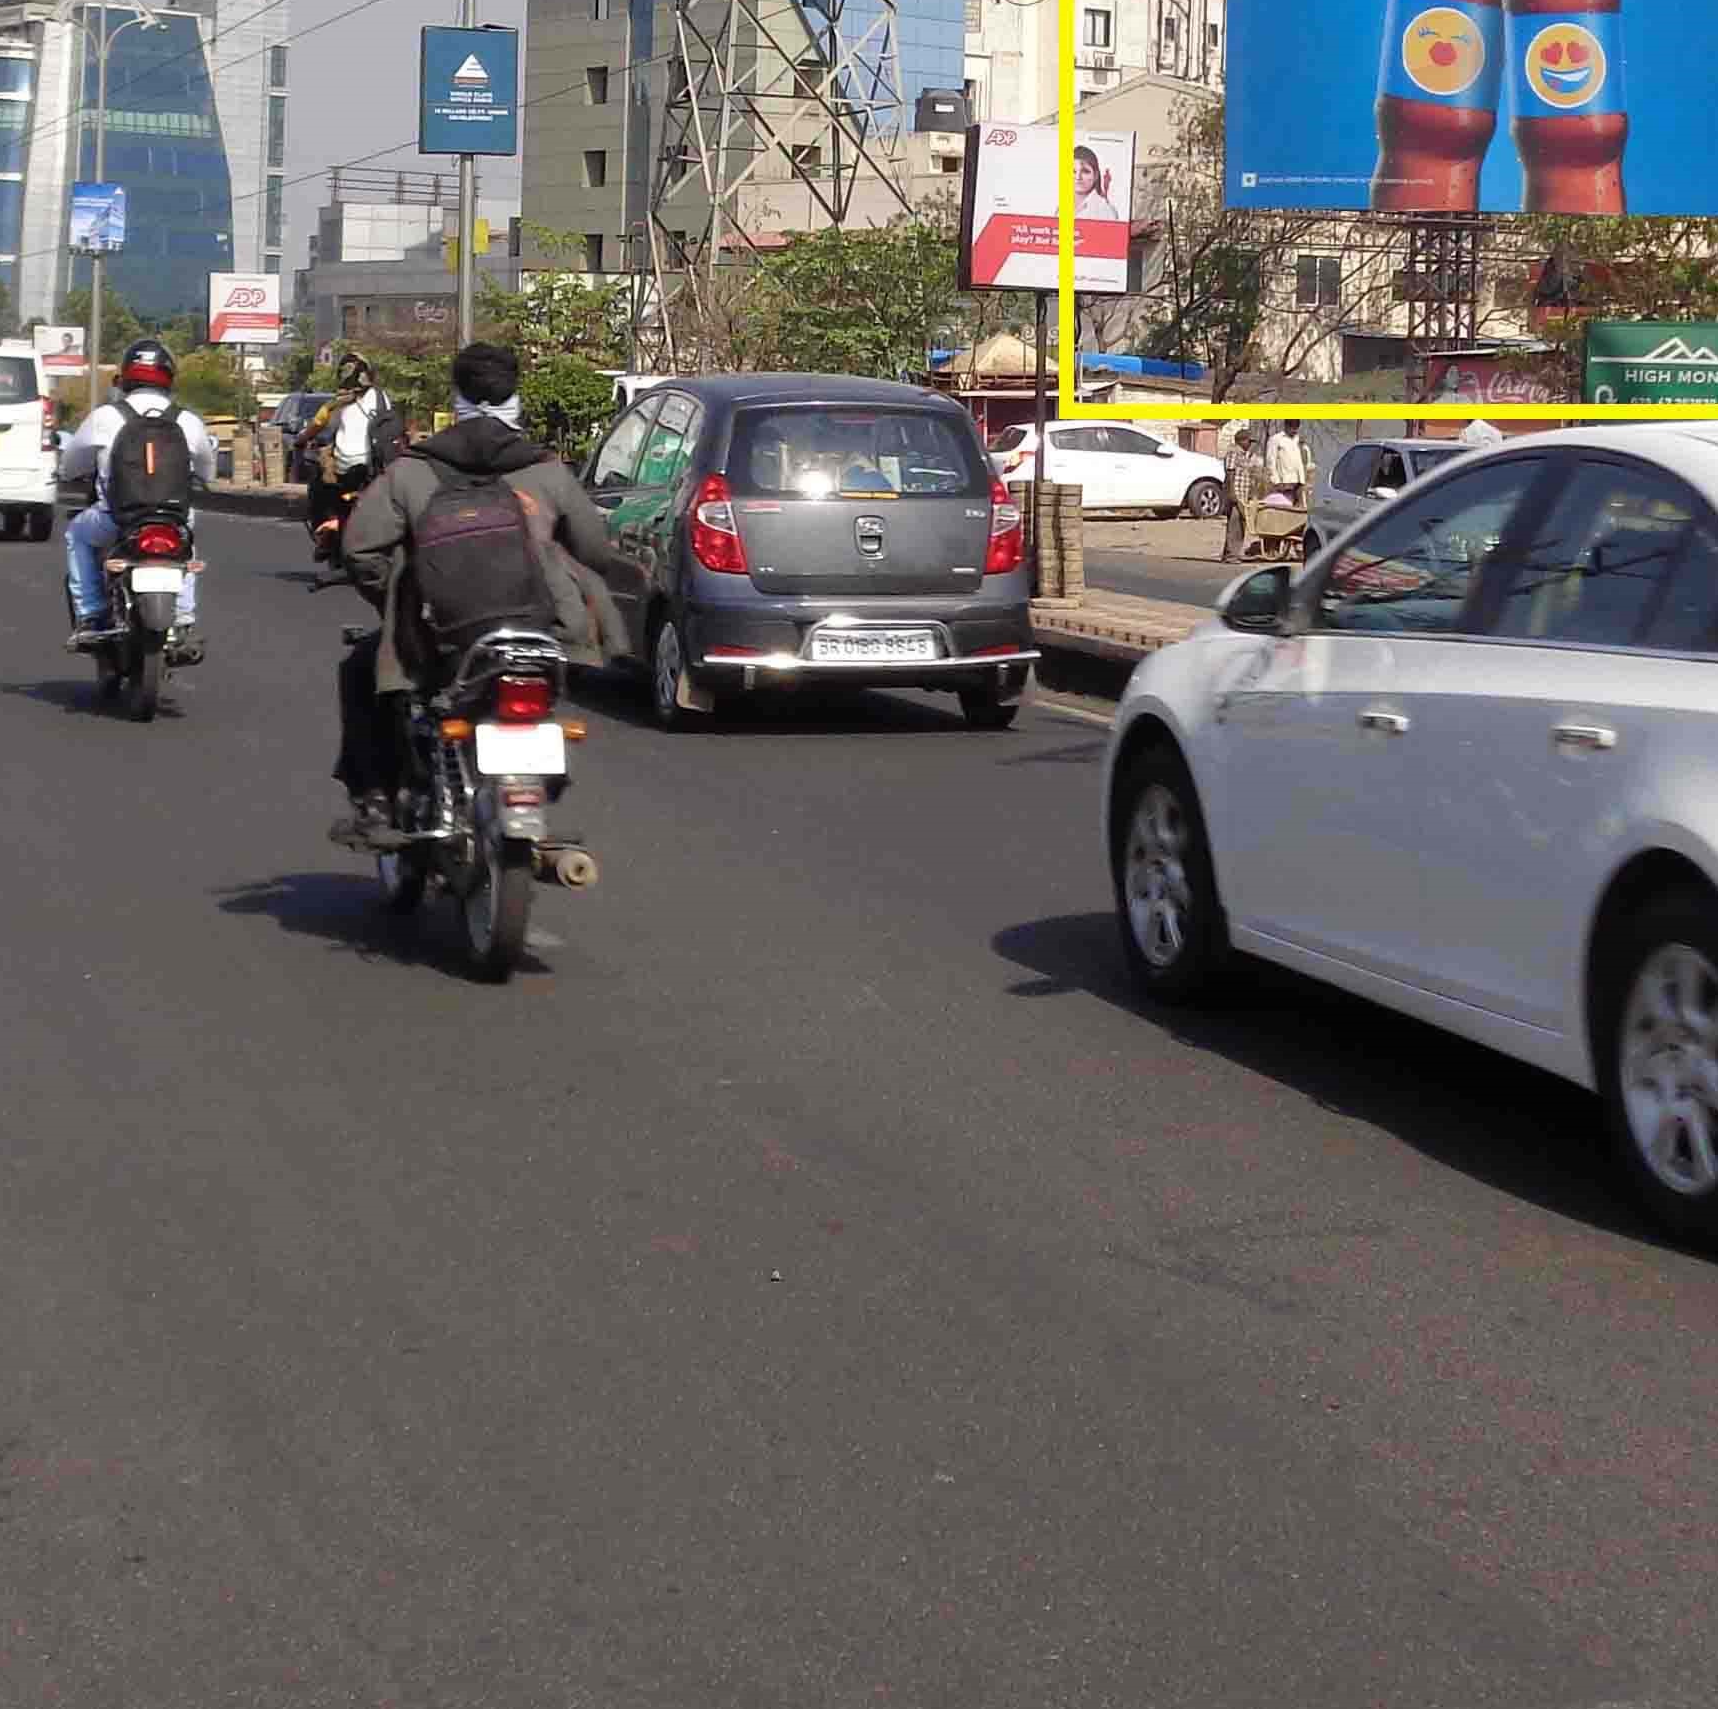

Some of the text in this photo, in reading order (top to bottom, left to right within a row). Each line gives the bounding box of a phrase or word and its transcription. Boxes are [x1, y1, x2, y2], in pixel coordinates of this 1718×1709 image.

[985, 129, 1017, 146] ADP
[224, 287, 266, 307] ADP
[1624, 368, 1672, 383] HIGH
